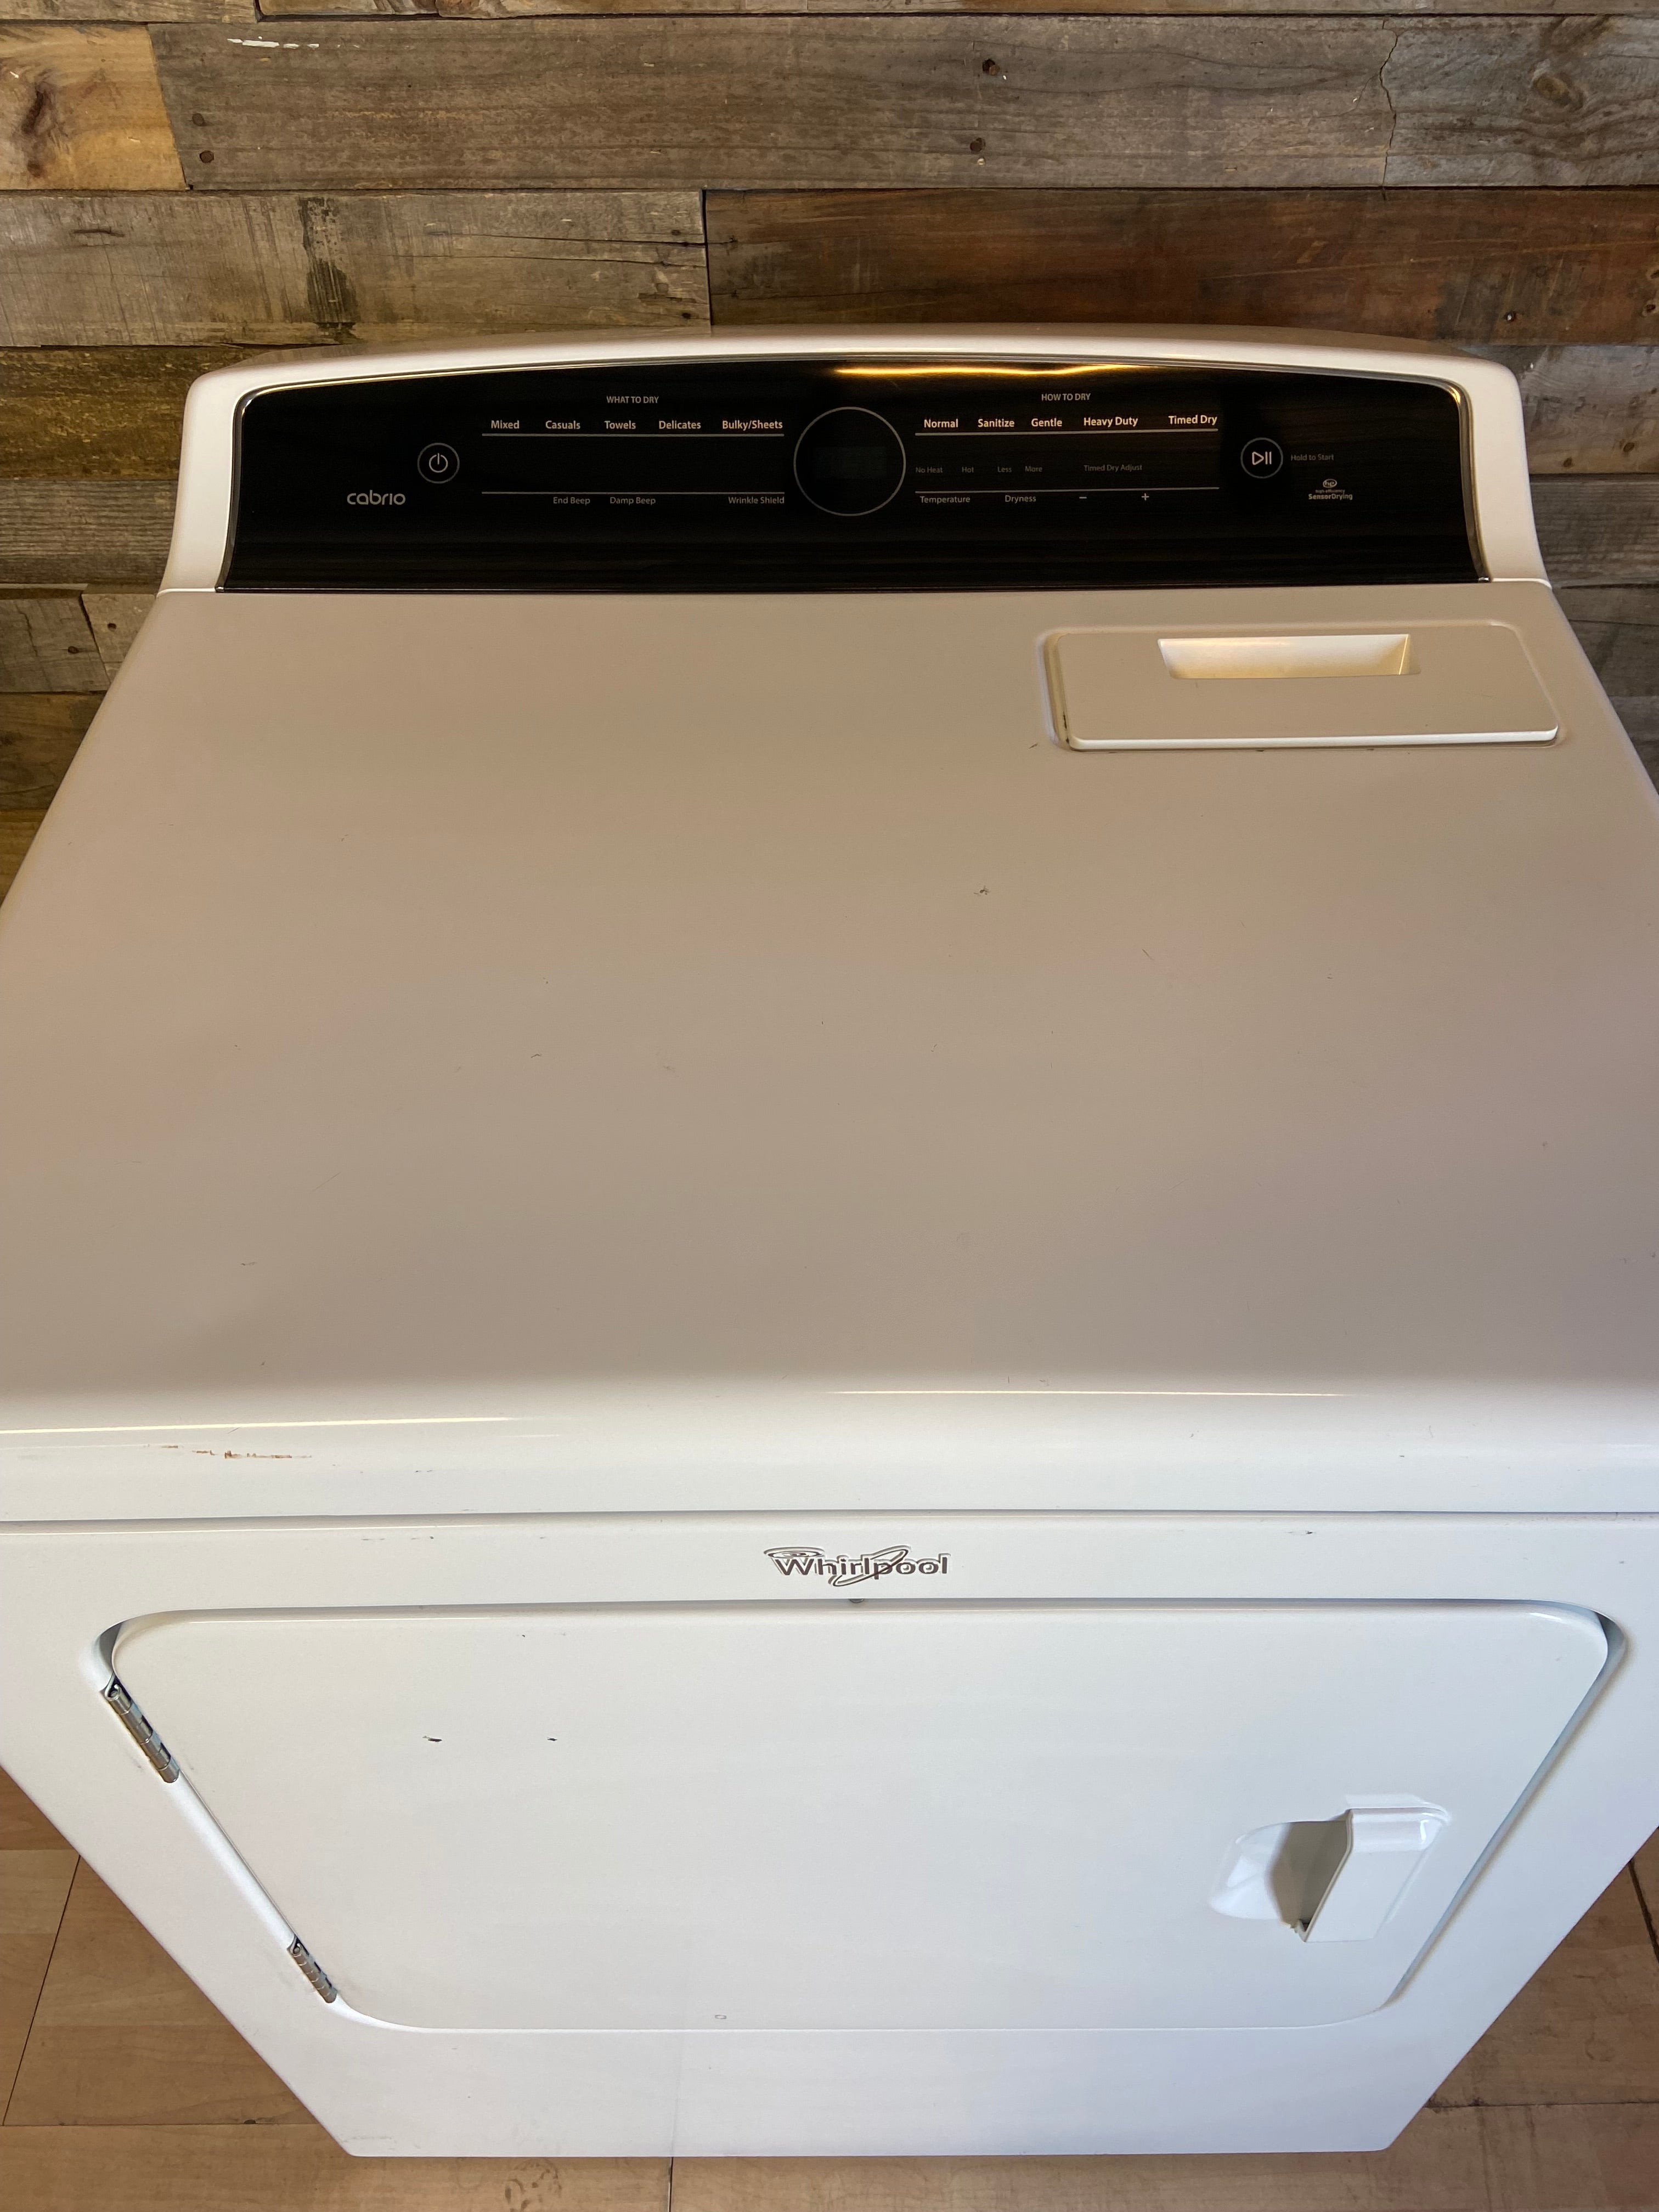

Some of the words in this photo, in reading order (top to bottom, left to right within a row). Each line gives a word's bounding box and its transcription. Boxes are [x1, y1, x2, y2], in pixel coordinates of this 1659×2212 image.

[606, 396, 630, 404] WHAT
[491, 420, 520, 429] Mixed
[545, 420, 580, 430] Casuals
[604, 420, 636, 430] Towels
[658, 420, 701, 430] Delicates
[722, 419, 783, 431] Bulky/Sheets
[924, 418, 958, 428] Normal
[978, 418, 1015, 427] Sanitize
[1031, 417, 1063, 427] Gentle
[1084, 417, 1113, 428] Heavy
[1115, 416, 1138, 427] Duty
[1168, 414, 1198, 425] Timed
[1200, 415, 1217, 426] Dry
[1107, 464, 1119, 472] Dry
[1120, 464, 1142, 472] Adjust
[347, 489, 406, 505] cabrio
[570, 496, 590, 505] Beep
[610, 496, 634, 505] Damp
[636, 496, 656, 505] Beep
[919, 495, 970, 505] Temperature
[1005, 494, 1036, 504] Dryness
[765, 1545, 950, 1586] Whirlpool
